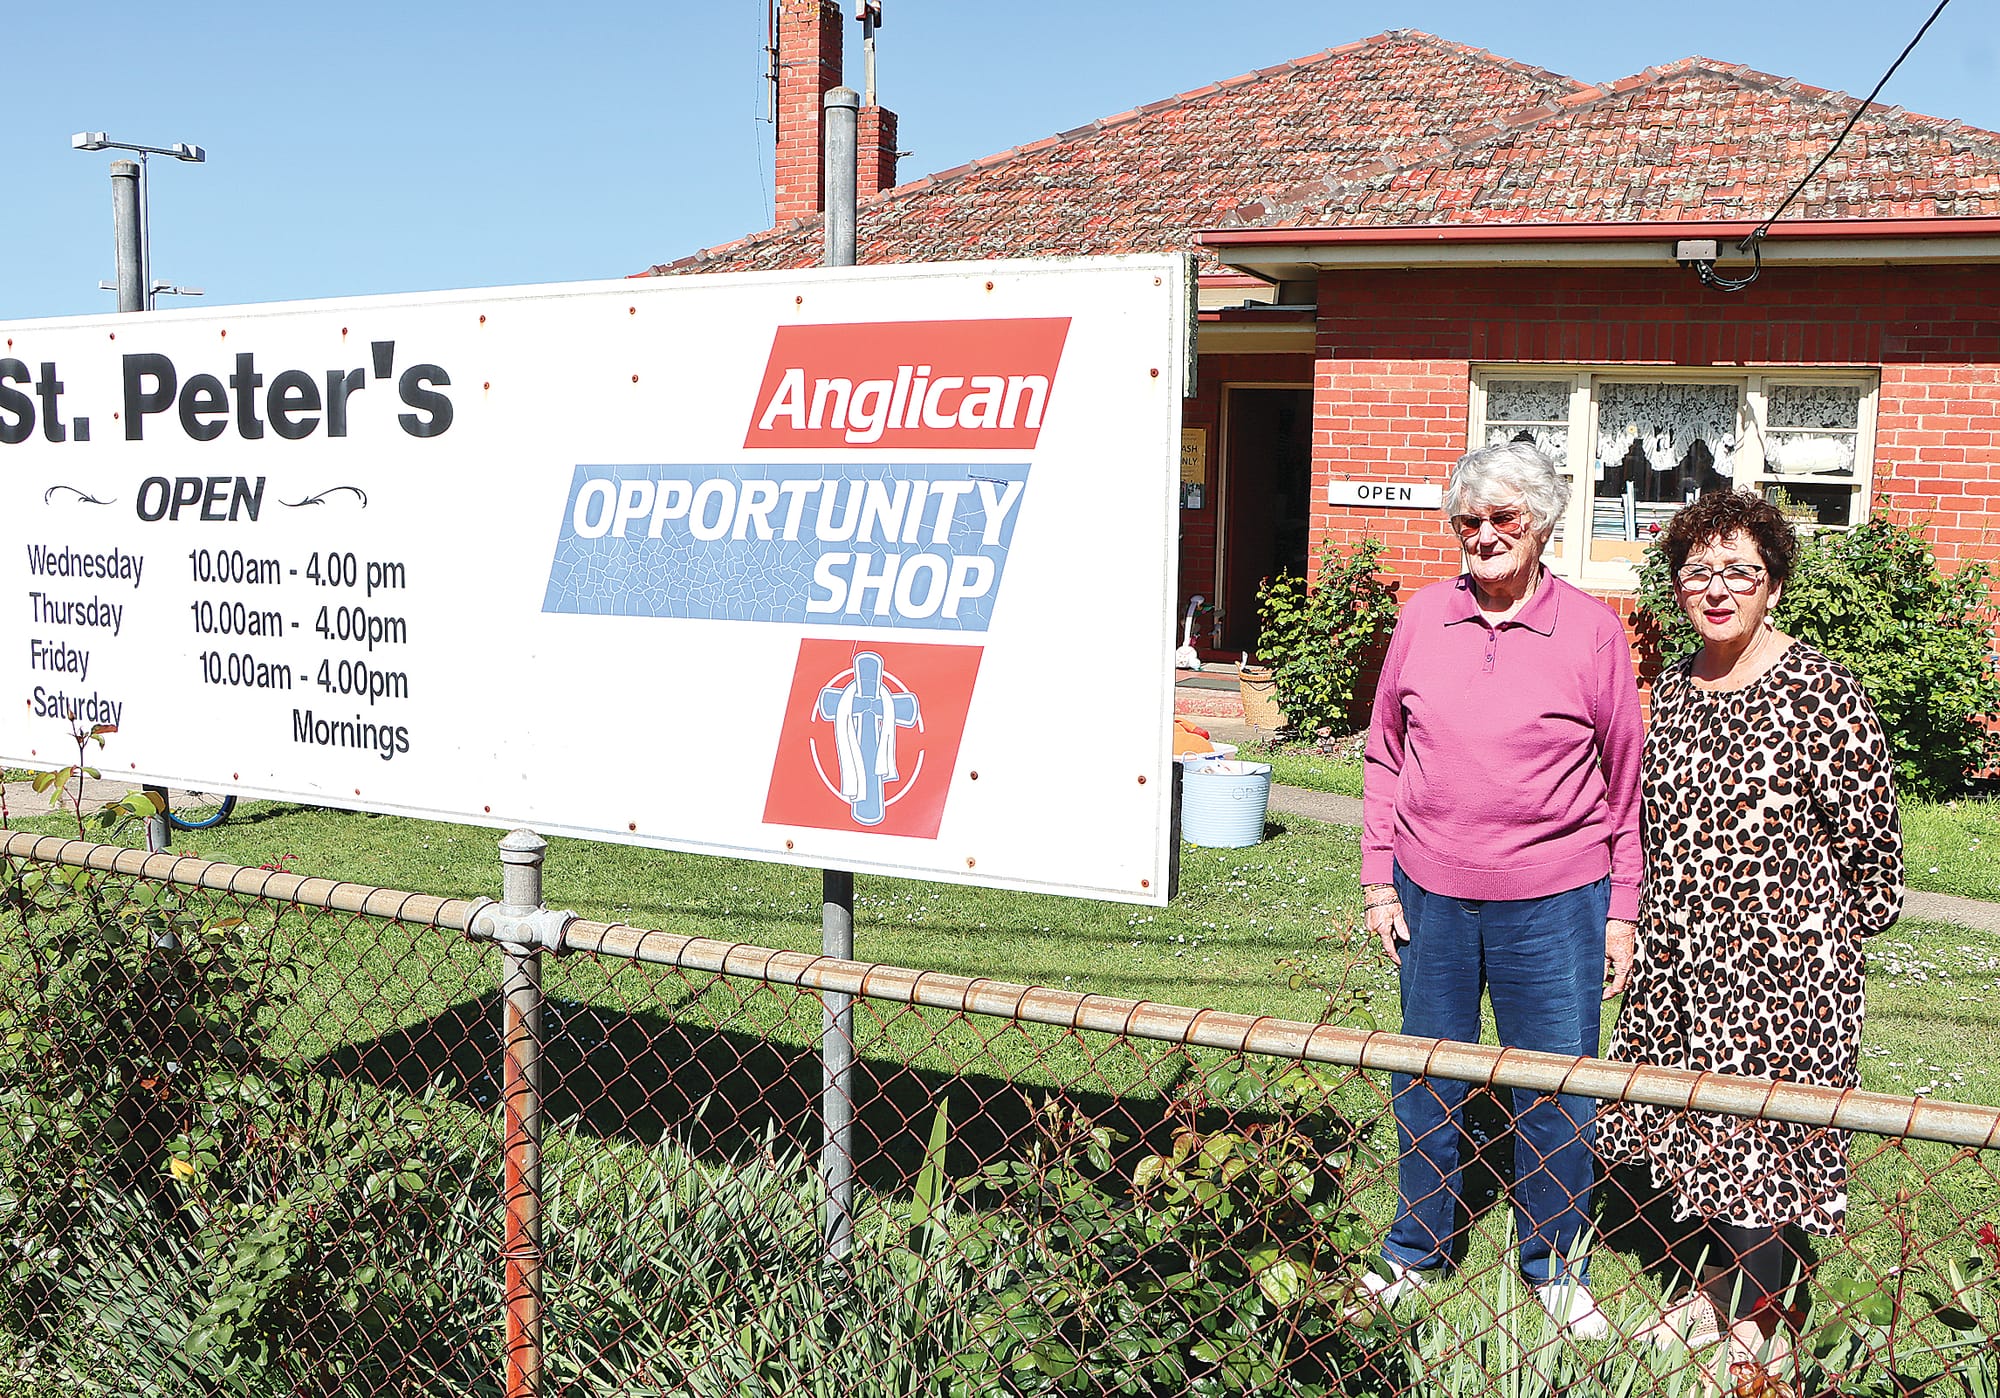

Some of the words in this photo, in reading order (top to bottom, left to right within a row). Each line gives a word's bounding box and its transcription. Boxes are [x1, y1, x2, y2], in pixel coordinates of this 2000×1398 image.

[0, 358, 91, 444] St.
[122, 340, 454, 442] Peter's
[758, 364, 1049, 444] Anglican
[1181, 445, 1198, 453] ASH
[1181, 457, 1198, 466] NLY
[136, 476, 266, 522] OPEN
[572, 477, 1025, 546] OPPORTUNITY
[1357, 485, 1412, 501] OPEN
[27, 544, 144, 589] Wednesday
[188, 549, 281, 585] 10.00am
[306, 552, 357, 588] 4.00
[366, 561, 406, 597] pm
[804, 551, 996, 619] SHOP
[29, 592, 123, 637] Thursday
[190, 600, 283, 637] 10.00am
[315, 606, 407, 652] 4.00pm
[30, 638, 90, 682] Friday
[199, 651, 292, 690] 10.00am
[316, 658, 409, 706] 4.00pm
[33, 685, 123, 727] Saturday
[292, 708, 410, 761] Mornings
